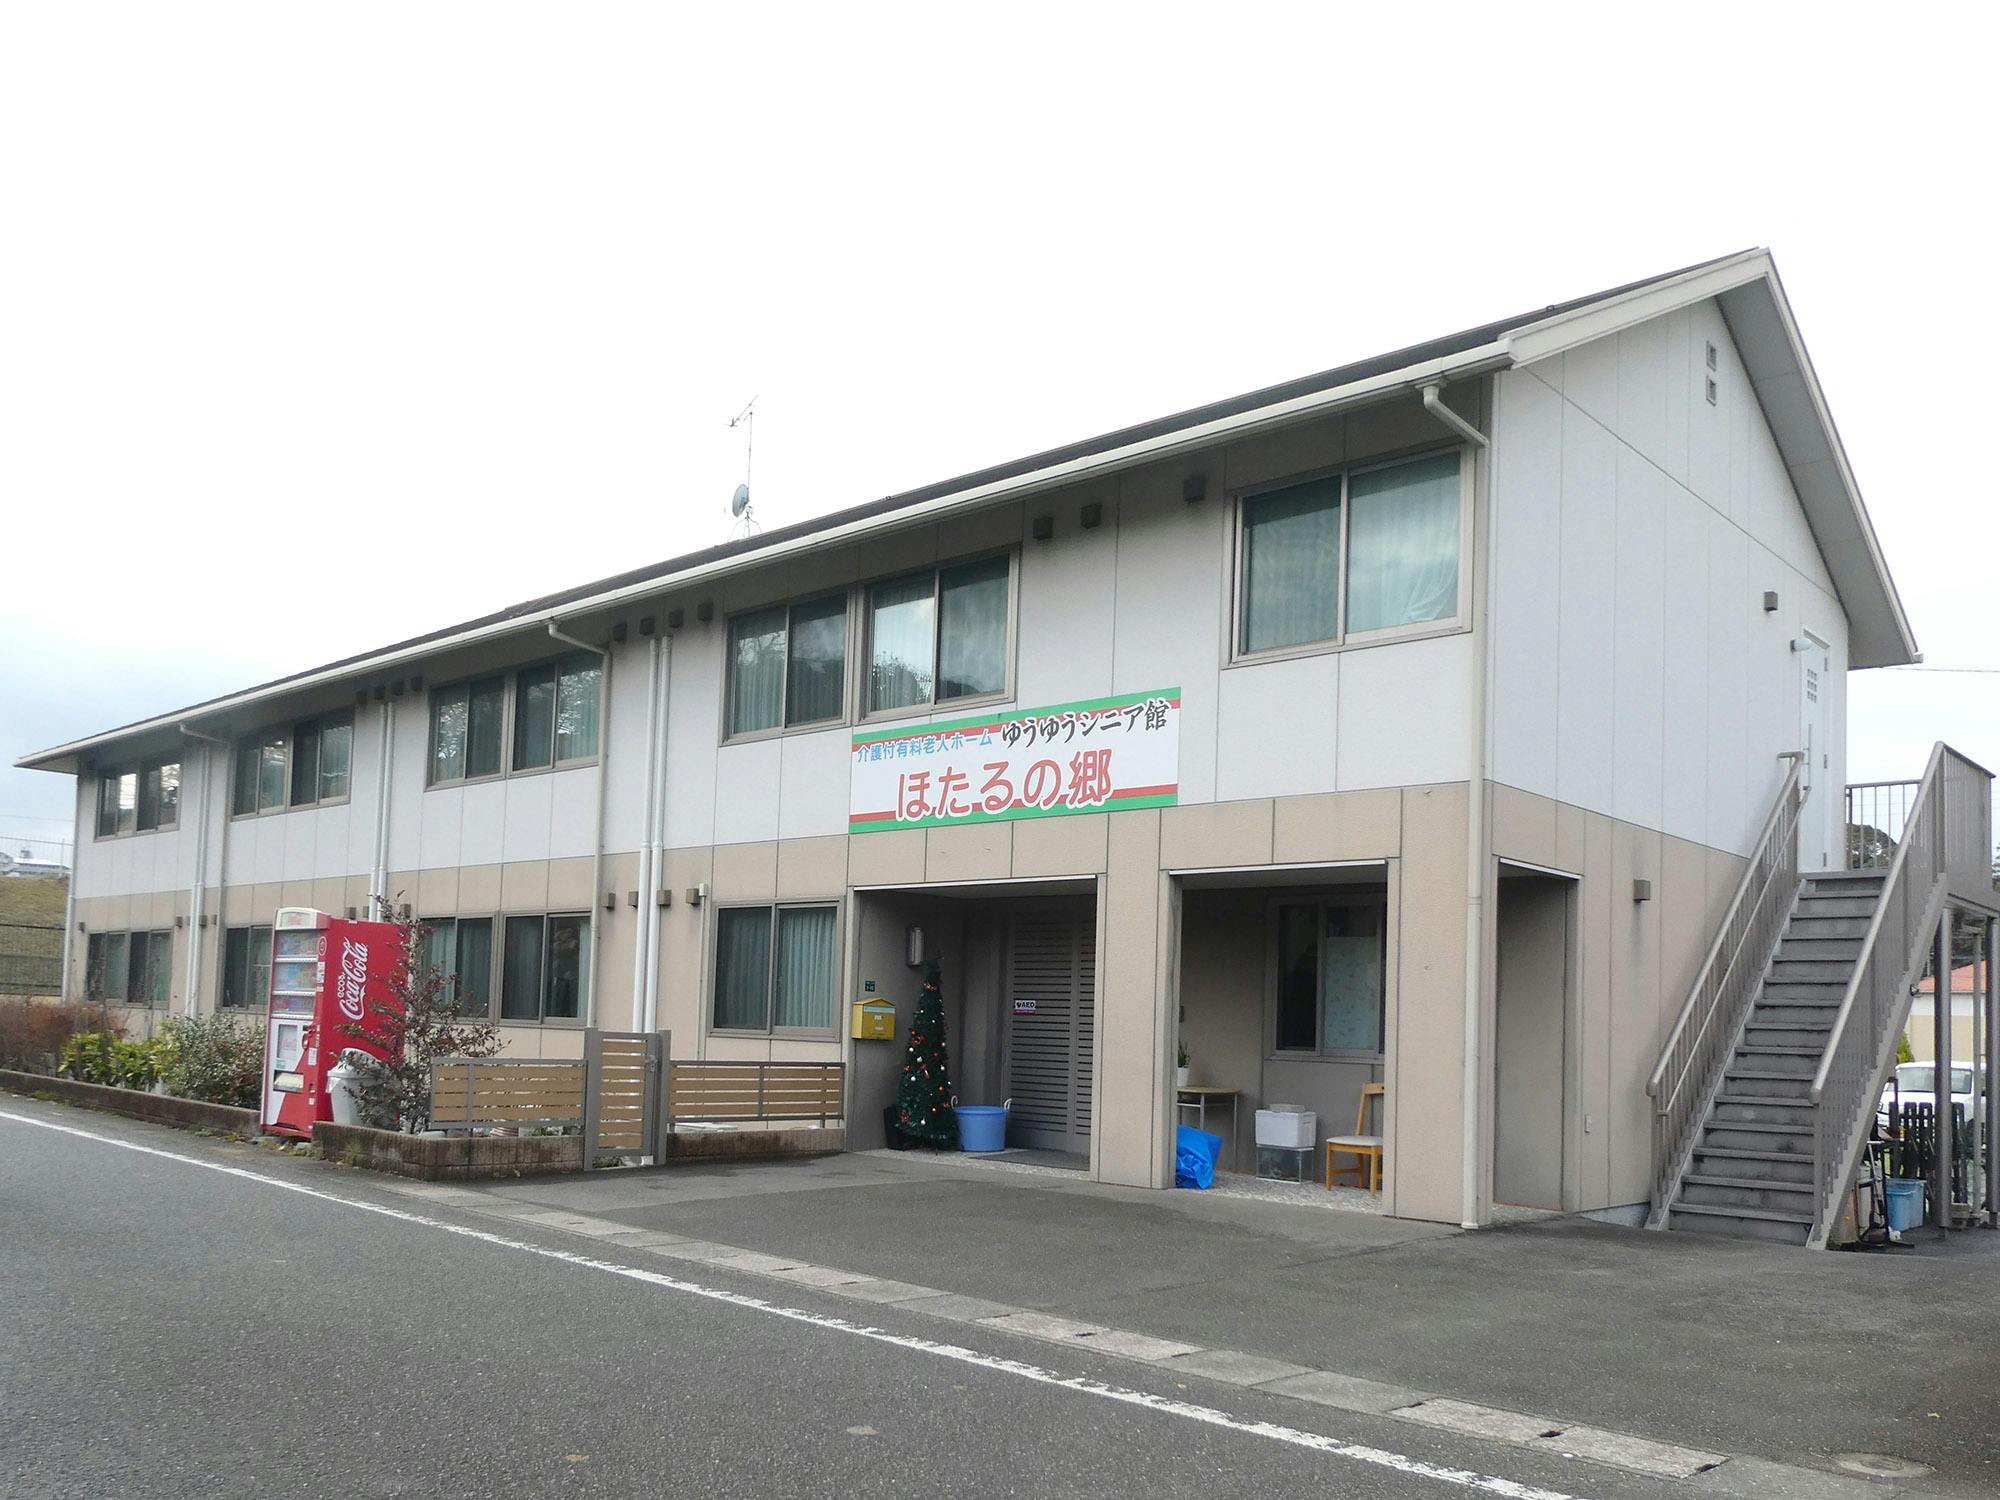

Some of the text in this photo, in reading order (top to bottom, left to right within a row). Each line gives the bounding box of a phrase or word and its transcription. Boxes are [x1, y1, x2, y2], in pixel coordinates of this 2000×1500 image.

[858, 700, 1169, 762] 介護付有料老人ホーム ゆうゆうシニア館
[898, 750, 1112, 818] ほたるの郷
[340, 937, 368, 1020] Coca-Cola
